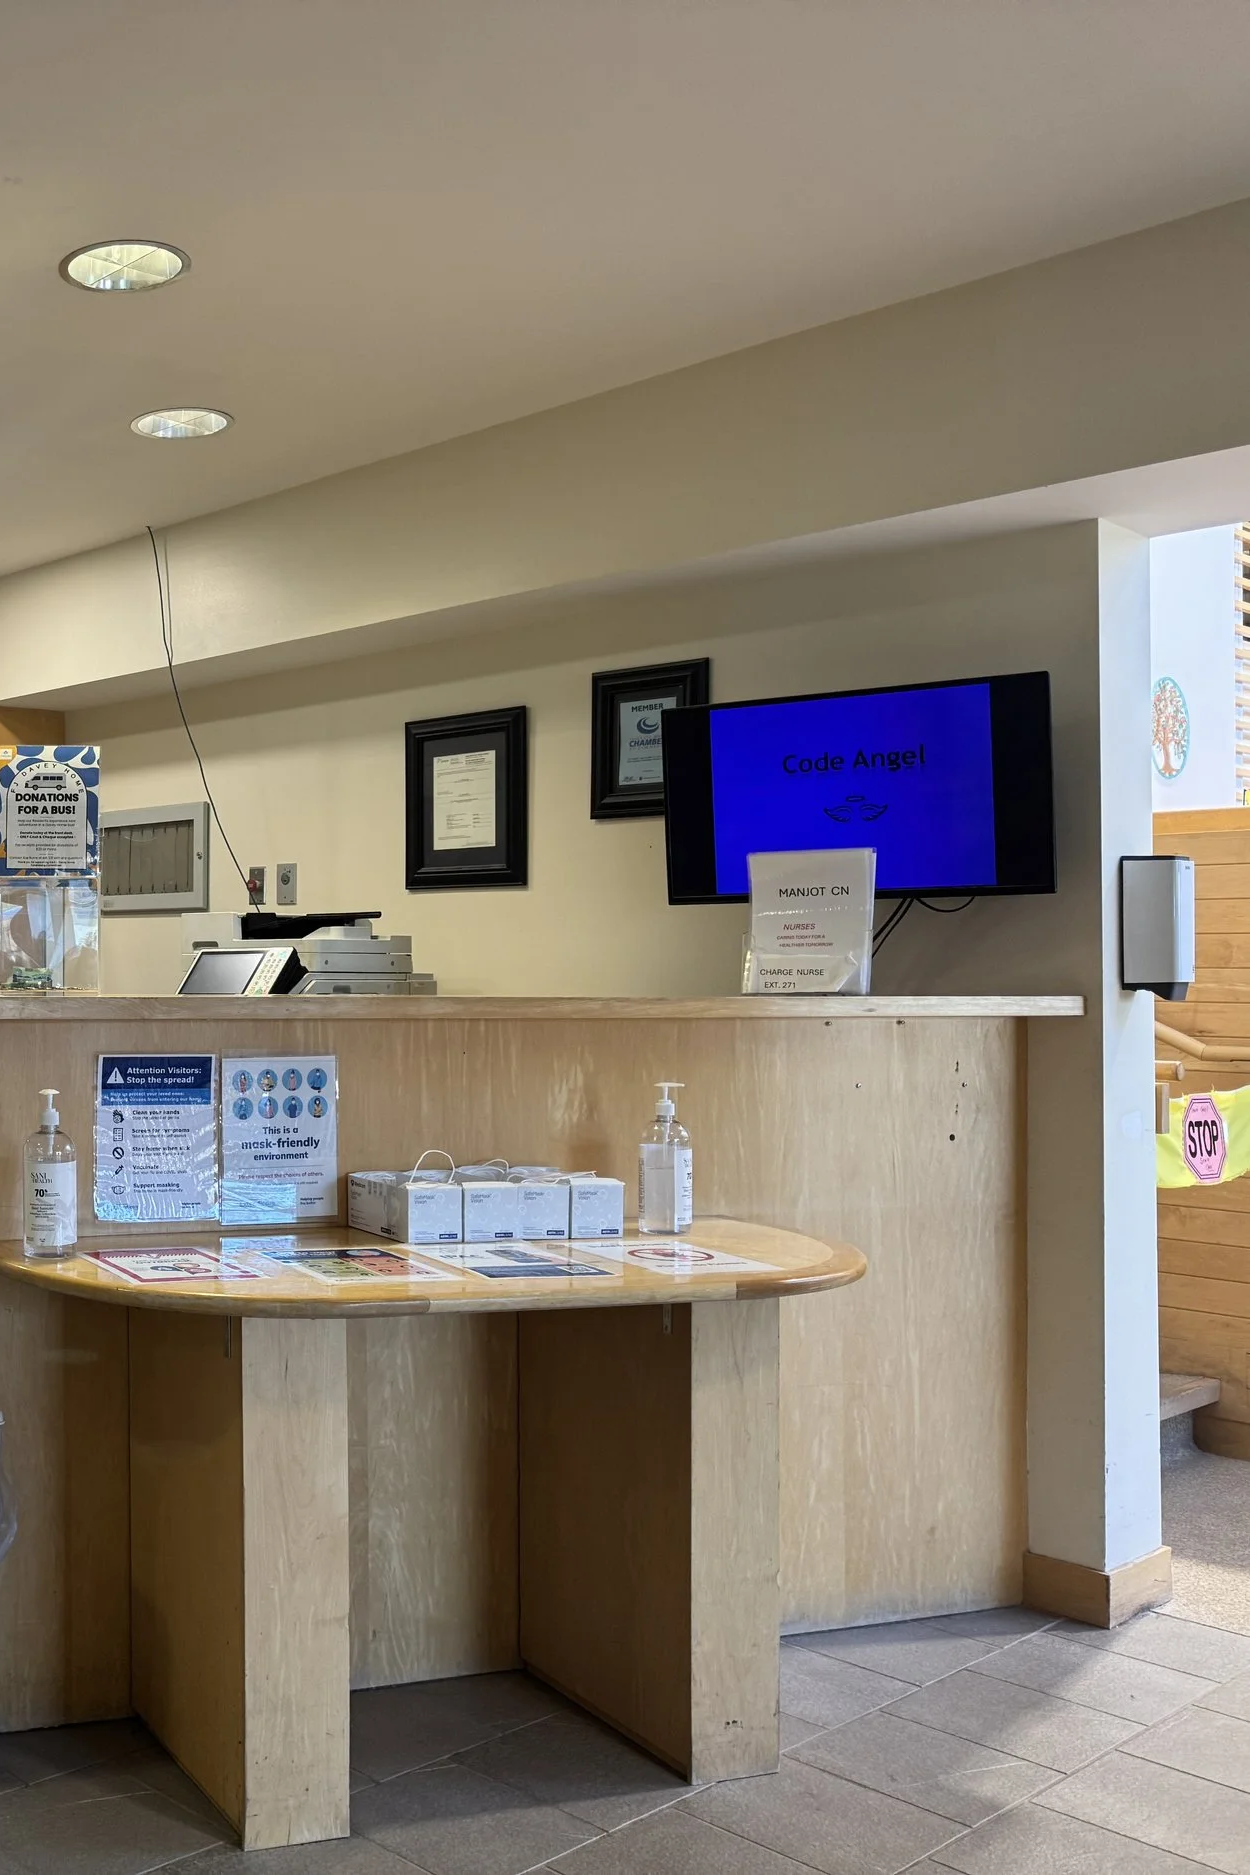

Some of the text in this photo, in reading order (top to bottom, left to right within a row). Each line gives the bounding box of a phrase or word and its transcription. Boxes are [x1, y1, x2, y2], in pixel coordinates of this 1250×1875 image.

[631, 703, 664, 712] MEMBER
[629, 738, 662, 747] CHAMBE
[782, 743, 926, 774] Code Angel
[21, 763, 57, 777] DAVEY
[64, 768, 85, 794] HOME
[15, 793, 79, 802] DONATIONS
[17, 805, 76, 814] FOR A BUS!
[779, 886, 850, 898] MANJOT CN
[783, 923, 816, 931] NURSES
[127, 1076, 146, 1085] Stop
[163, 1076, 194, 1085] spread!
[262, 1126, 281, 1135] This
[283, 1126, 290, 1134] is
[241, 1137, 320, 1150] mask-friendly
[1188, 1120, 1219, 1158] STOP
[254, 1152, 309, 1161] environment
